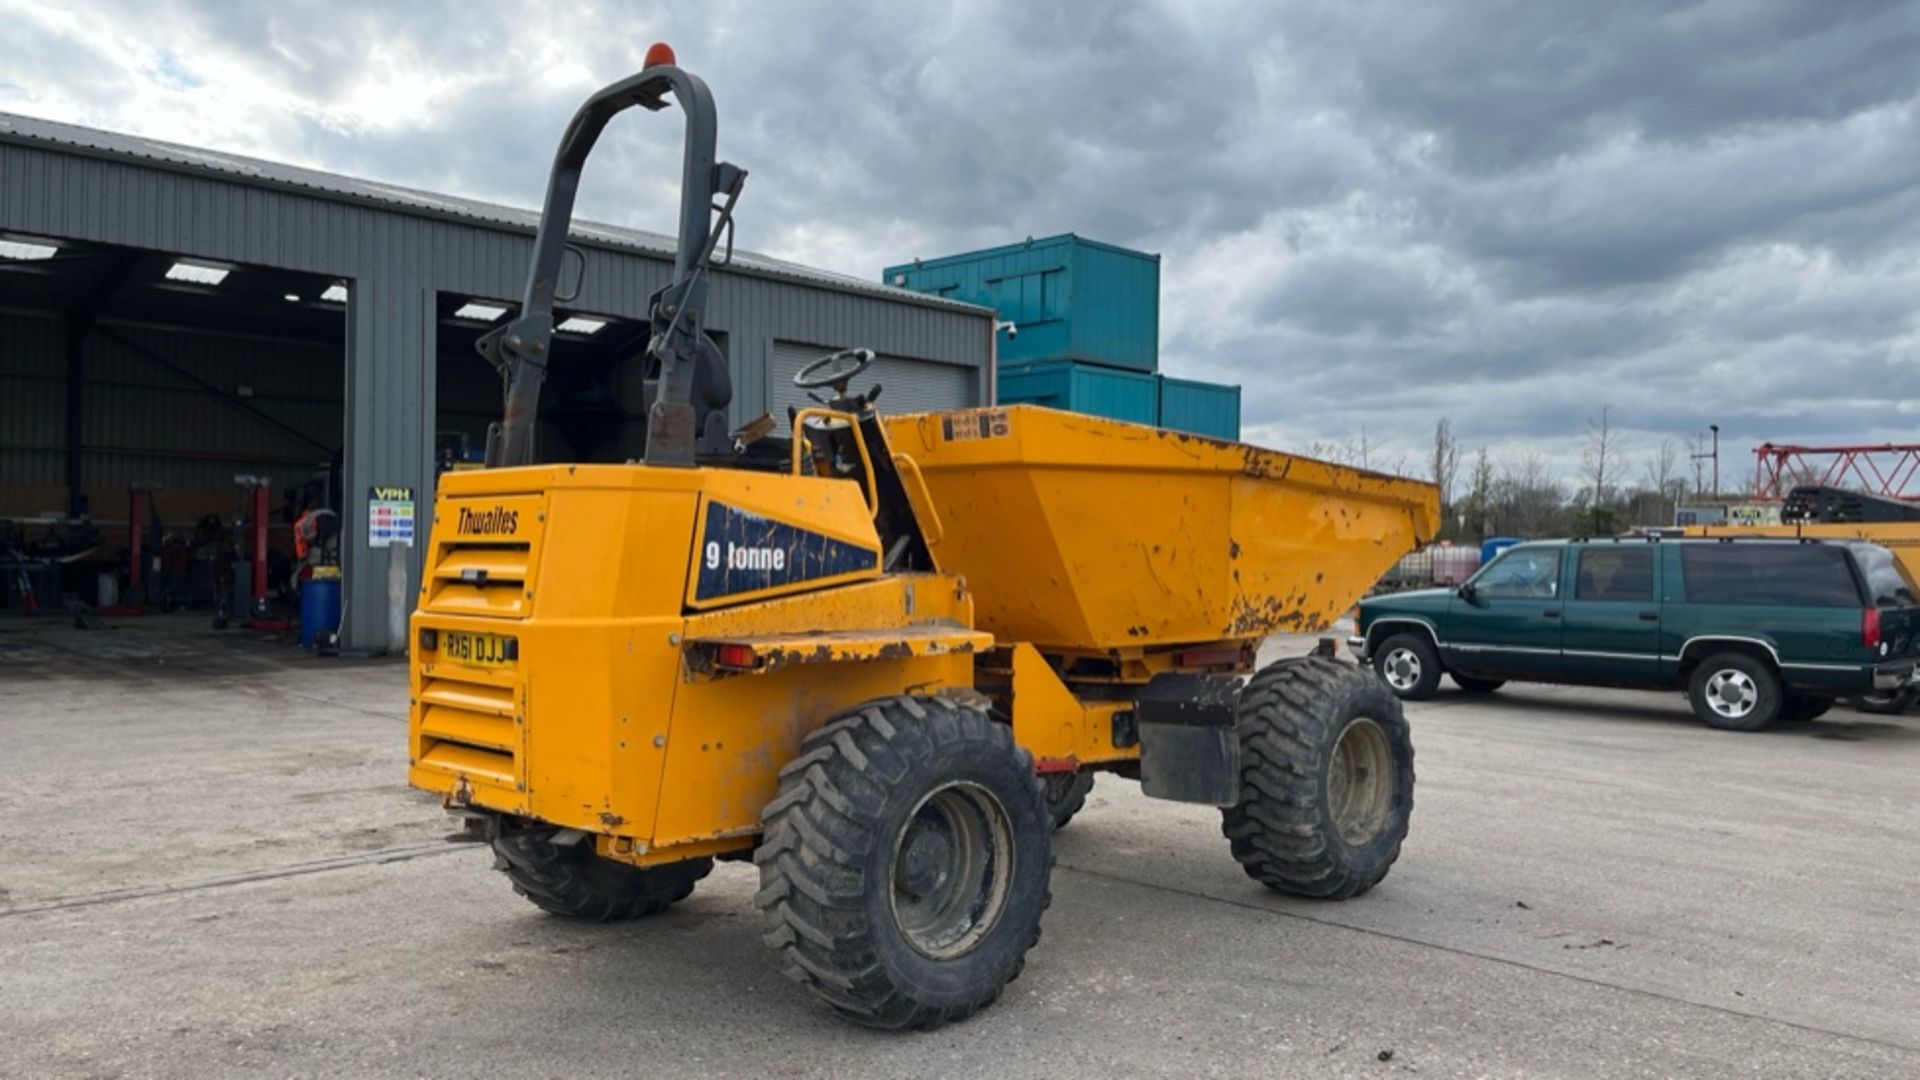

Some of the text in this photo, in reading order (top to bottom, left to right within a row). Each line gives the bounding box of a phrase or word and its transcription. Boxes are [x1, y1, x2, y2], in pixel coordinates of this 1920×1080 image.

[375, 487, 409, 500] VPH
[458, 506, 518, 534] Thwaites
[706, 541, 785, 570] 9 tonne
[447, 632, 505, 663] RX61 DJJ
